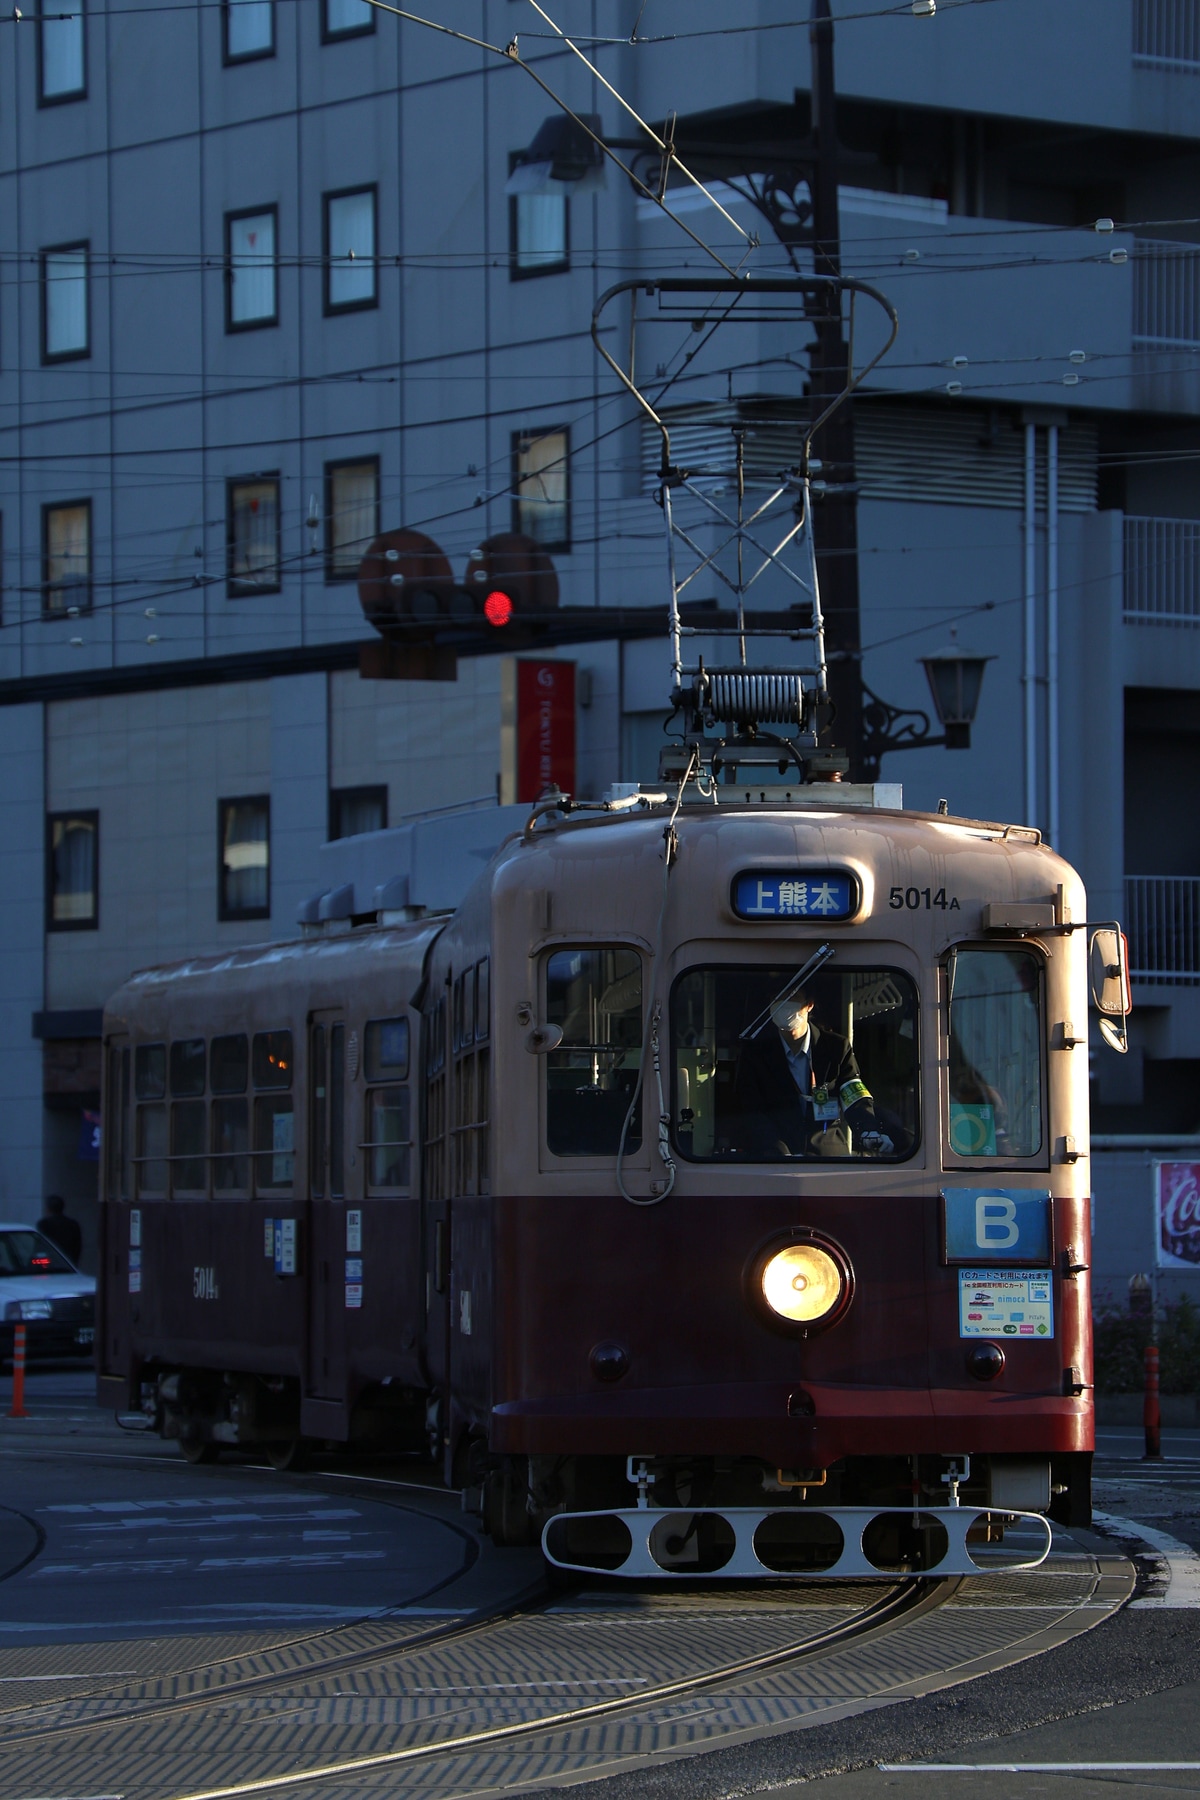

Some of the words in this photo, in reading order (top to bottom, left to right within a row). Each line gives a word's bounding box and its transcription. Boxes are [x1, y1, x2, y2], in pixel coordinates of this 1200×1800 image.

[747, 880, 840, 915] 上熊本
[975, 1196, 1019, 1249] B
[998, 1294, 1026, 1303] nimoca
